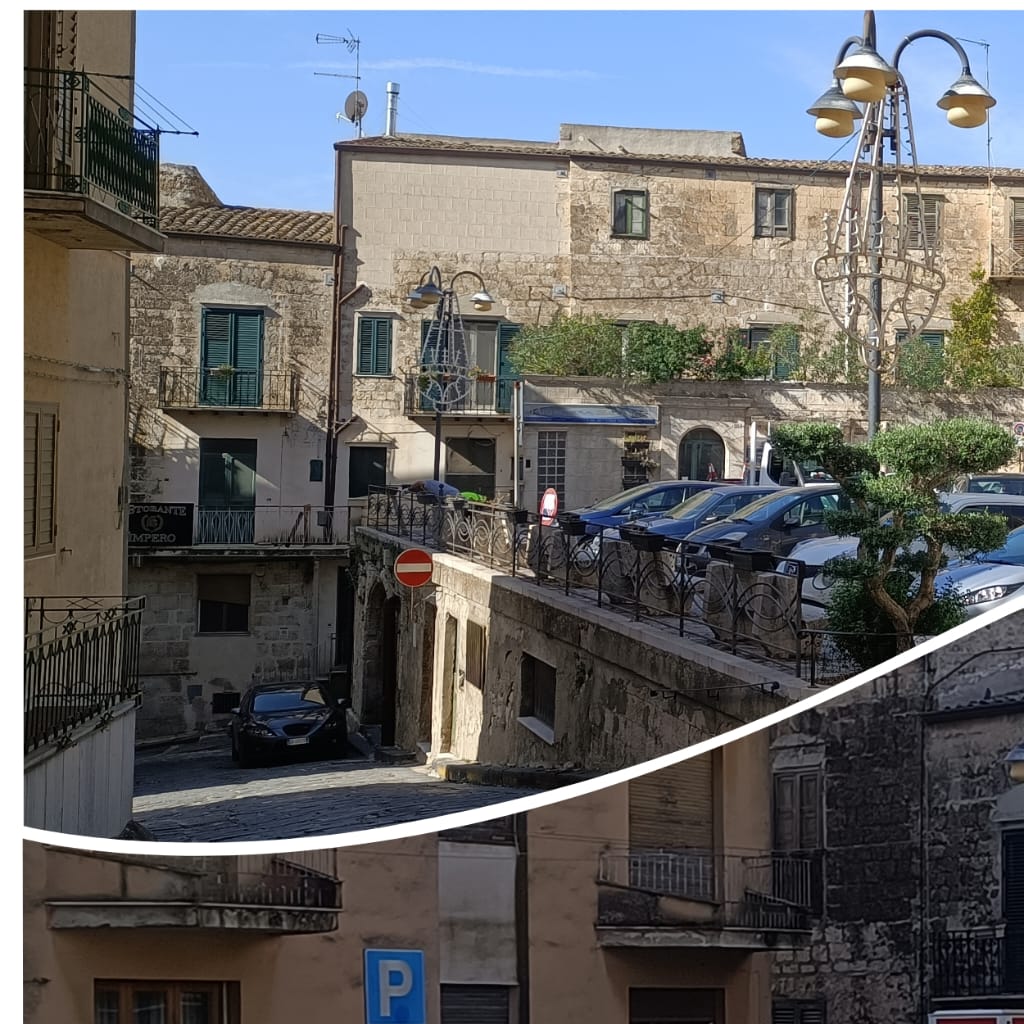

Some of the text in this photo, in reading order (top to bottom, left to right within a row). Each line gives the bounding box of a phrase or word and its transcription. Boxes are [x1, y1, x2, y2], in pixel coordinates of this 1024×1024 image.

[129, 505, 187, 516] STORANTE
[130, 533, 176, 543] IMPERO
[379, 960, 412, 1017] P
